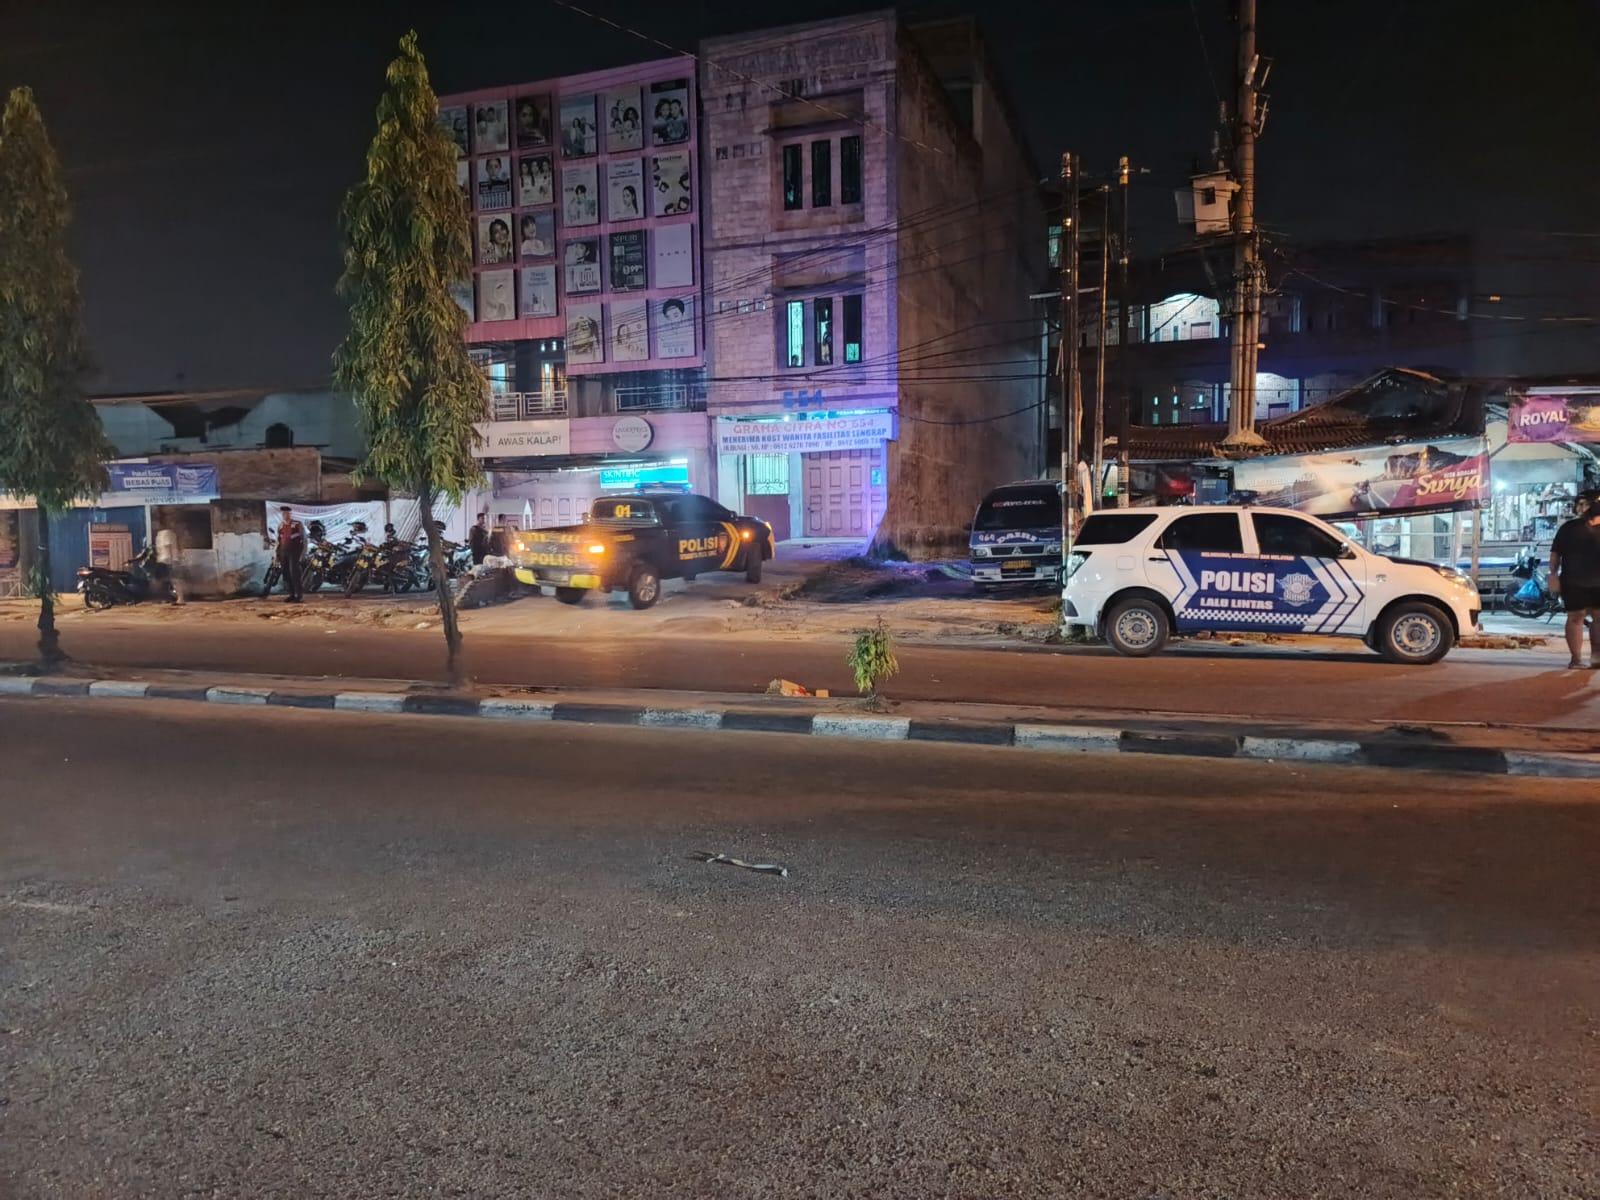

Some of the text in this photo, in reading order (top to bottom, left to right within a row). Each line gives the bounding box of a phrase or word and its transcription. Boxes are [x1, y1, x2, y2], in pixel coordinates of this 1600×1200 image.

[1519, 410, 1567, 427] ROYAL
[733, 423, 780, 434] GRAHA
[783, 420, 824, 432] CITRA
[826, 419, 848, 430] NO
[498, 435, 562, 446] AWAS KALAP!
[722, 435, 761, 444] MENERIMA
[783, 433, 812, 441] WANITA
[813, 431, 851, 440] FASILITAS
[852, 428, 887, 438] LENGKAP
[1416, 474, 1489, 500] Surya
[615, 504, 631, 518] 01
[679, 536, 719, 553] POLISI
[530, 553, 578, 566] POLISI
[1200, 570, 1275, 594] POLISI
[1200, 597, 1274, 610] LALU LINTAS
